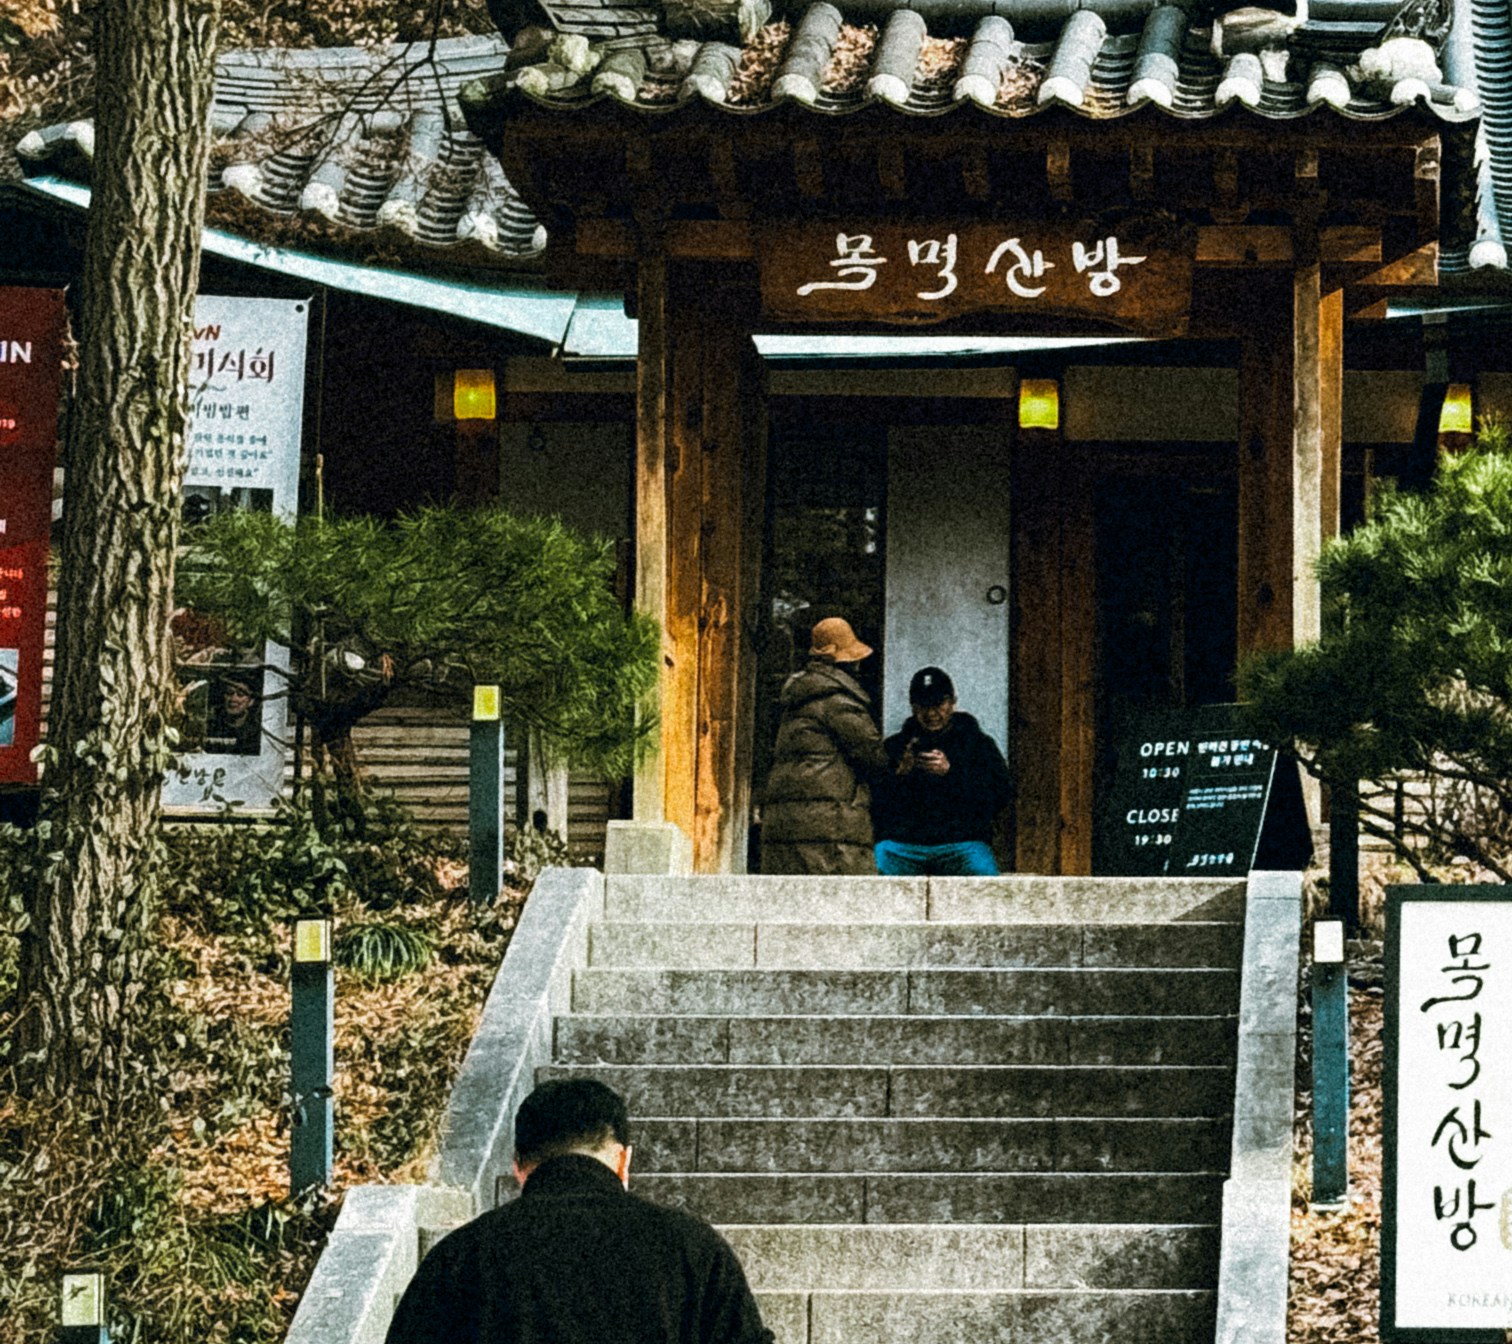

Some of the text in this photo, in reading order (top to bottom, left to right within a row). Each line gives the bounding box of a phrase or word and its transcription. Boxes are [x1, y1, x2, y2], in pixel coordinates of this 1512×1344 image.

[796, 232, 1147, 301] 목멱산방
[193, 324, 222, 341] vN
[1140, 740, 1190, 757] OPEN
[1142, 766, 1180, 779] 10:30
[1126, 808, 1180, 824] CLOSE
[1134, 833, 1173, 846] 19:30
[1419, 931, 1497, 1252] 목멱산방
